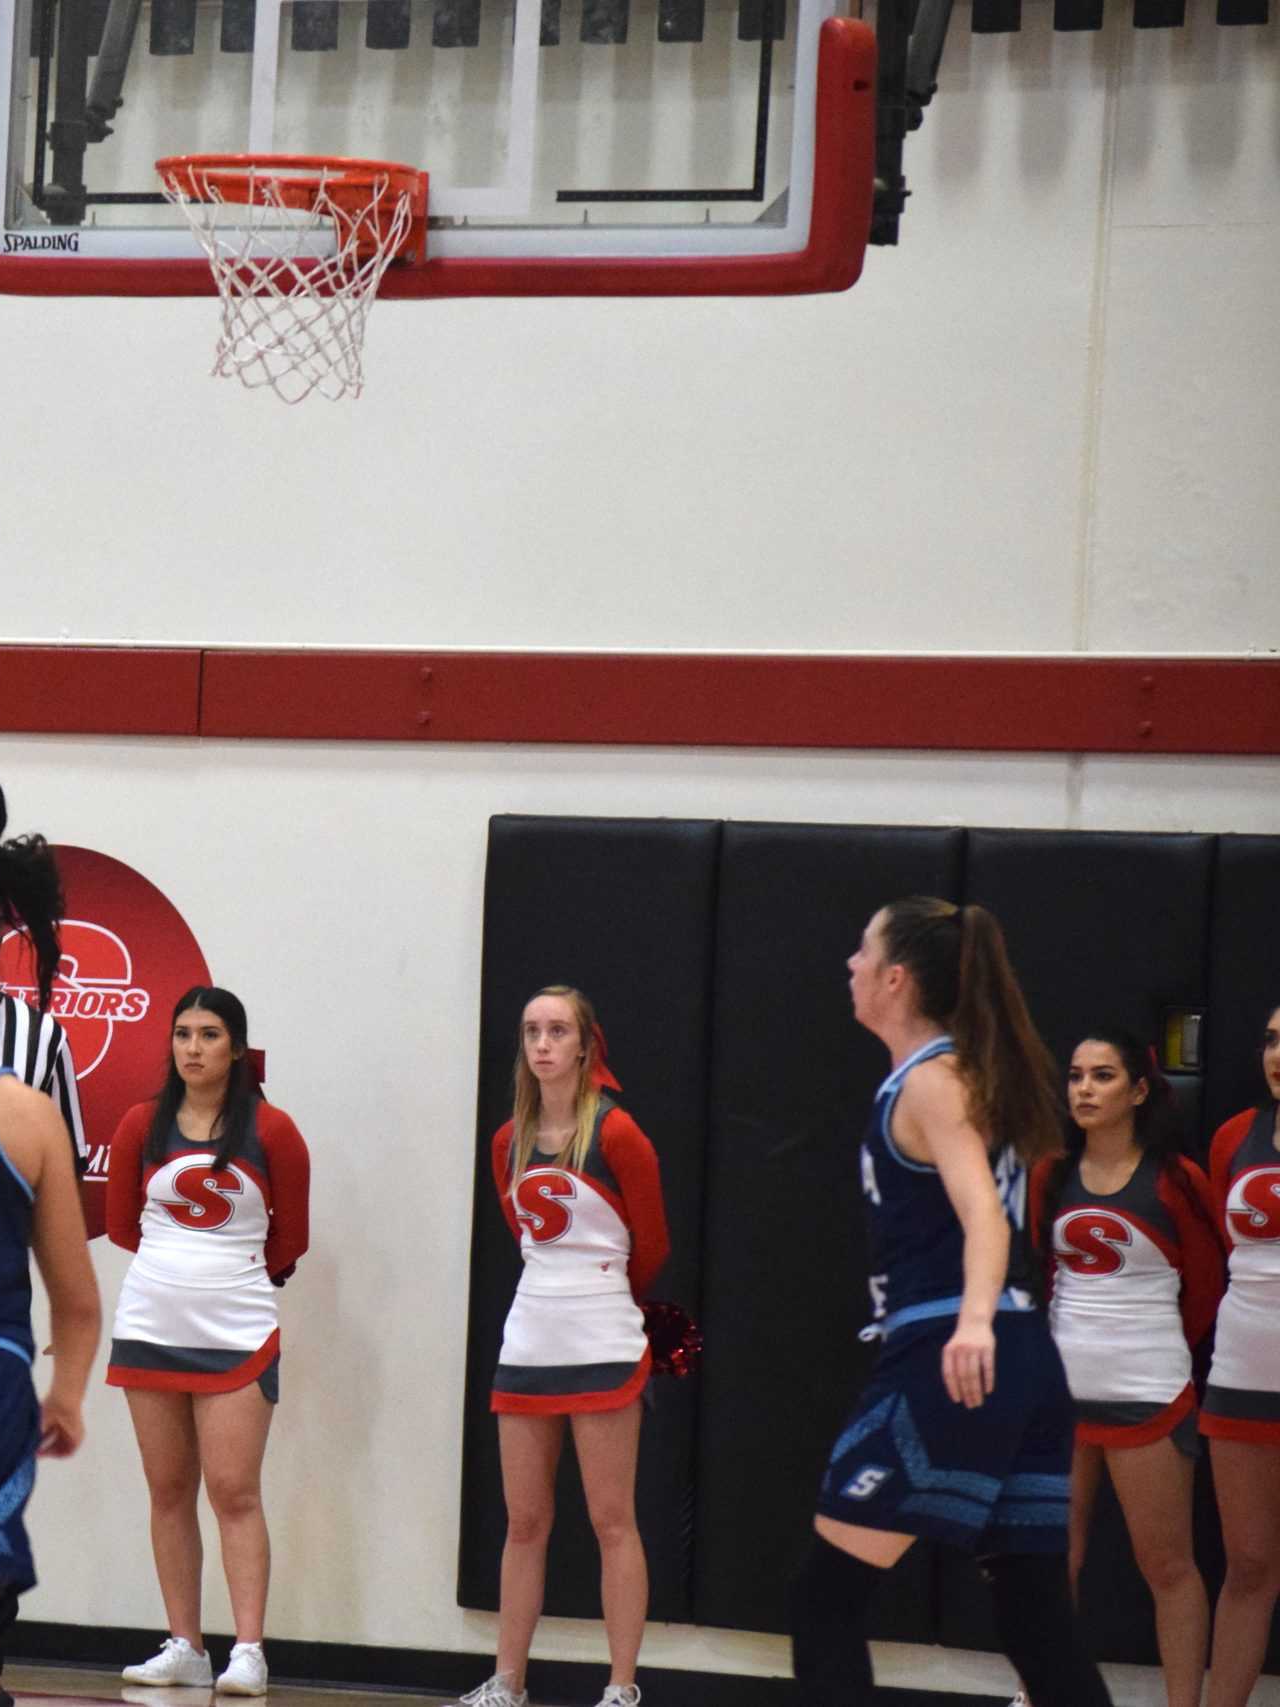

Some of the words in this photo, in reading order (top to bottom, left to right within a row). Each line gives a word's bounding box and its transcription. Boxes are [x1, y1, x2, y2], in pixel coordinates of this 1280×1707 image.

[4, 232, 79, 253] SPALDING
[151, 1163, 246, 1233] S
[515, 1170, 577, 1246] S
[1046, 1210, 1133, 1279] S
[846, 1468, 887, 1497] S
